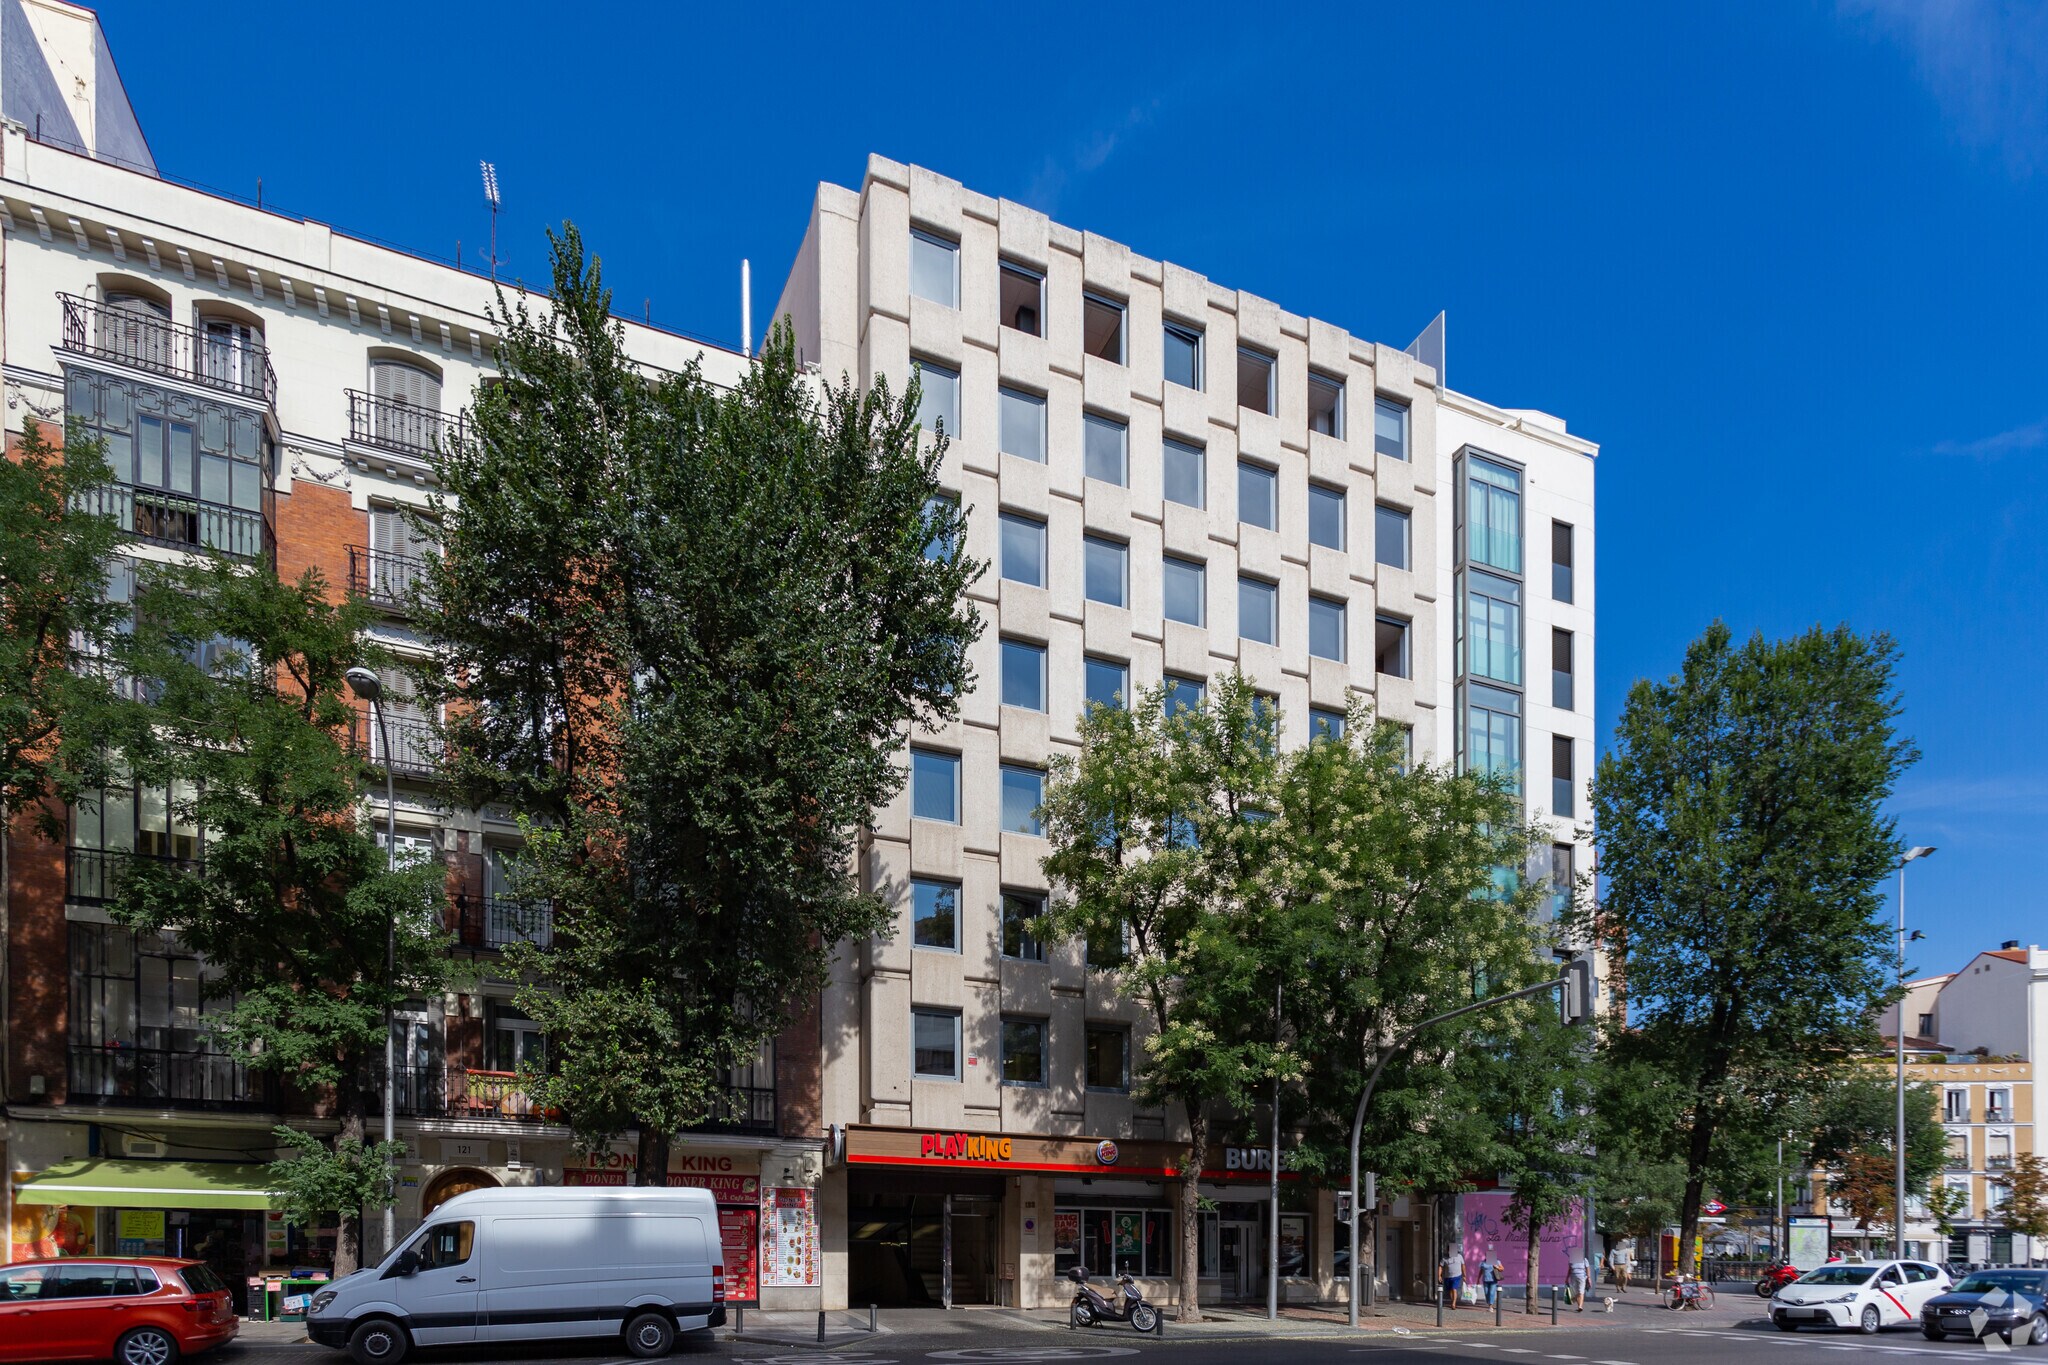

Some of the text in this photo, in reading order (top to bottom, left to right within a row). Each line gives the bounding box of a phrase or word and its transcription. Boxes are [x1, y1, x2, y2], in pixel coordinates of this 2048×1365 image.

[457, 1145, 471, 1154] 121
[590, 1152, 732, 1172] DON KING
[1226, 1147, 1299, 1171] BURG
[585, 1174, 624, 1185] DONER
[666, 1175, 740, 1190] DONER KING
[1486, 1231, 1562, 1243] La Malluina
